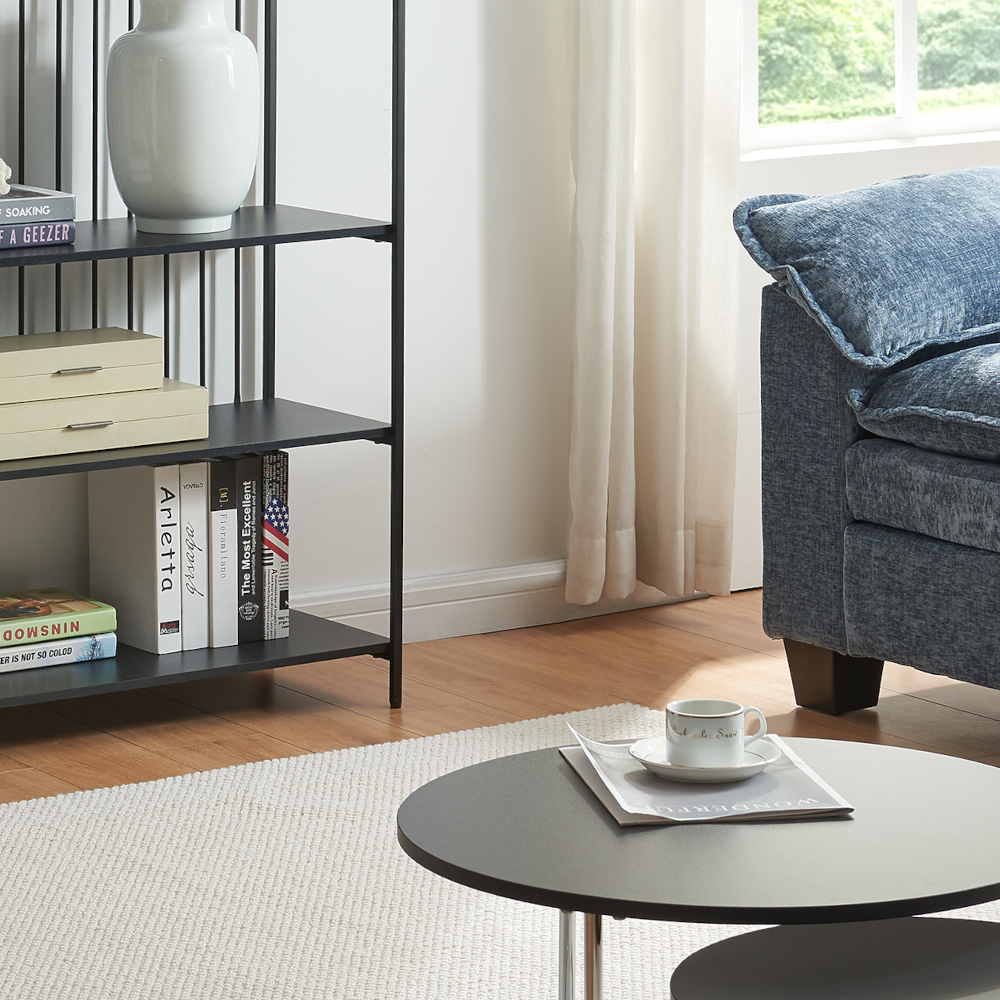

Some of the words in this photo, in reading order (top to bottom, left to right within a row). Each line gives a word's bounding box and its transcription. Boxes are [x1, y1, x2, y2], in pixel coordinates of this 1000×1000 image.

[5, 205, 51, 217] SOAKING
[9, 228, 17, 244] A
[23, 223, 70, 244] GEEZER
[241, 480, 252, 538] Excellent
[160, 486, 177, 592] Arletta
[220, 513, 228, 579] Fieramilano
[241, 540, 251, 570] Most
[241, 573, 251, 597] The
[11, 654, 19, 664] IS
[21, 652, 36, 663] NOT
[37, 650, 47, 660] SO
[49, 647, 73, 659] COLOD
